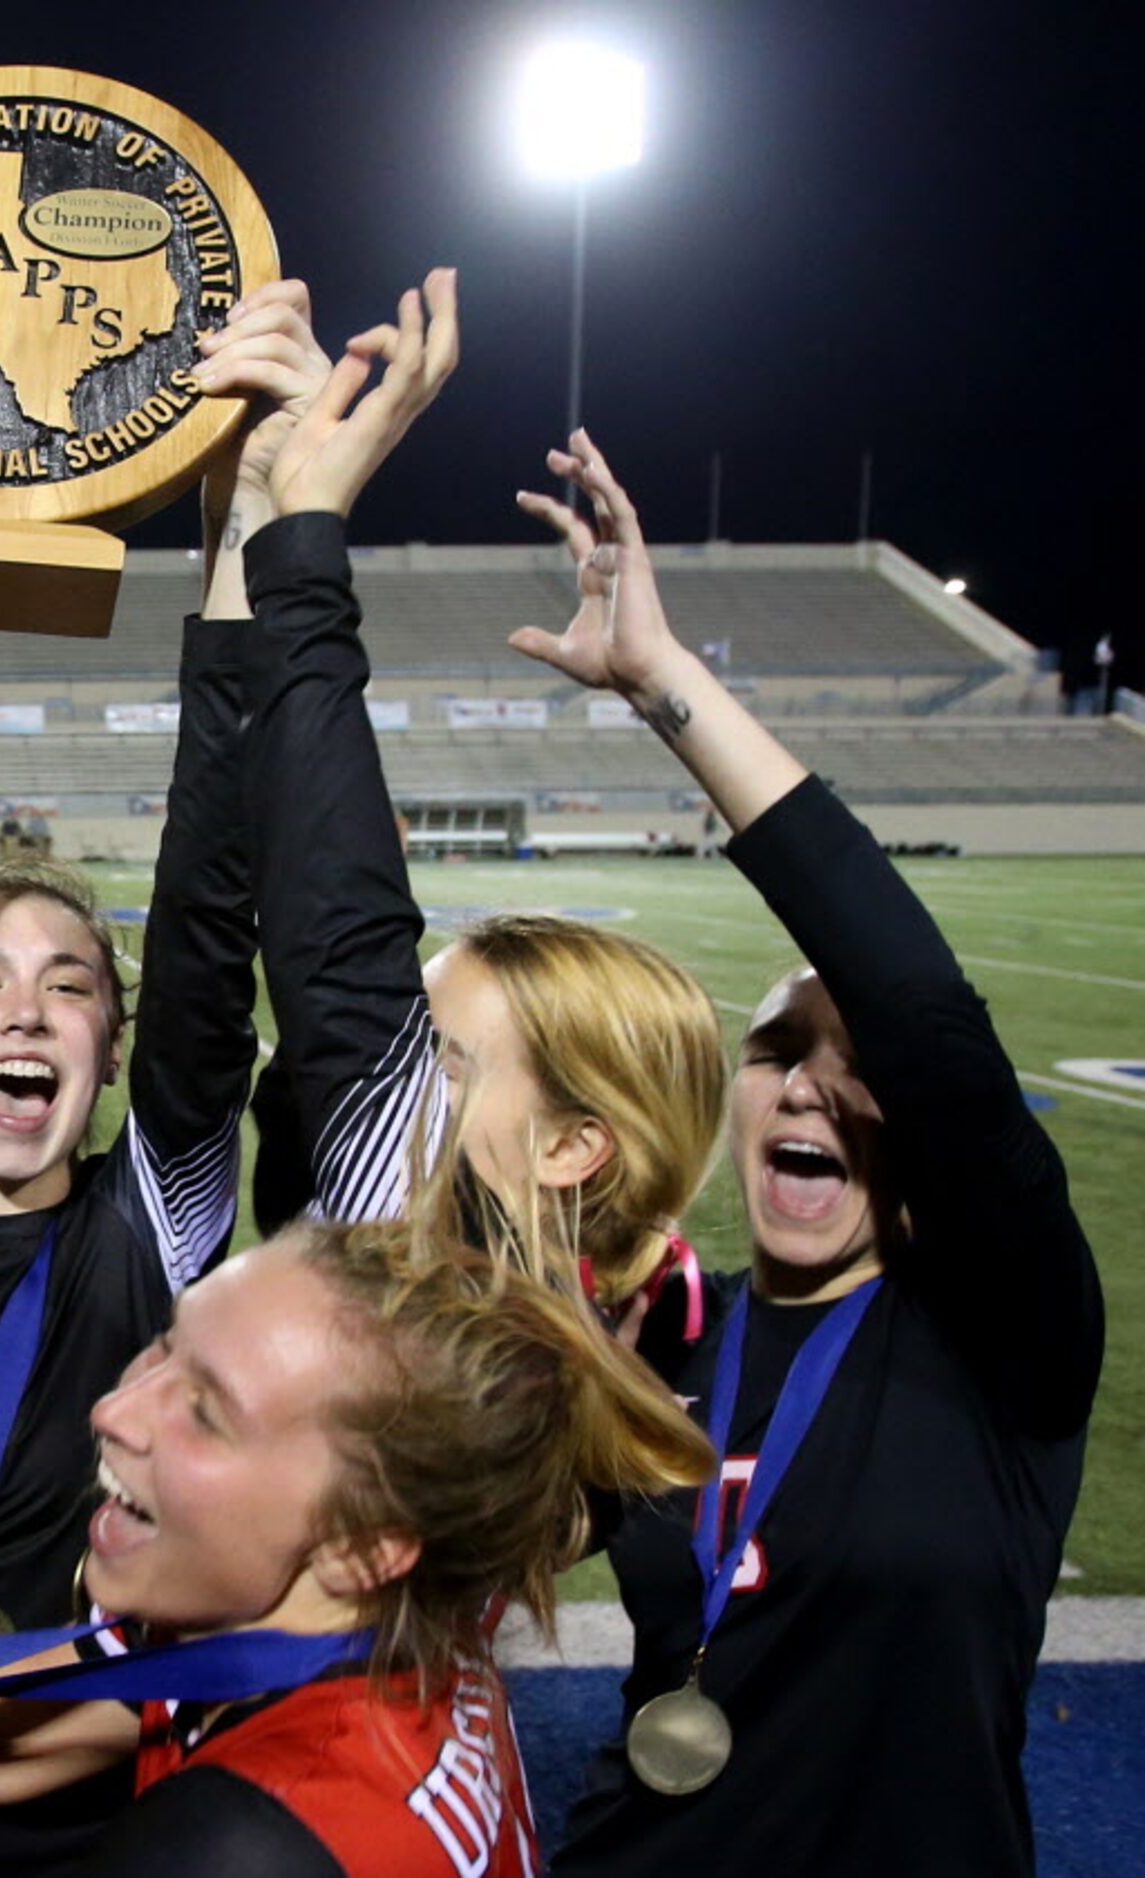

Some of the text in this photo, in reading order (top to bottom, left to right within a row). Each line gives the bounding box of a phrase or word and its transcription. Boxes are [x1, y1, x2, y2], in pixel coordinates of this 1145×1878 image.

[33, 206, 164, 234] Champion
[116, 131, 168, 168] OF
[165, 175, 235, 309] PRIVATE
[64, 369, 201, 470] SCHOOLS
